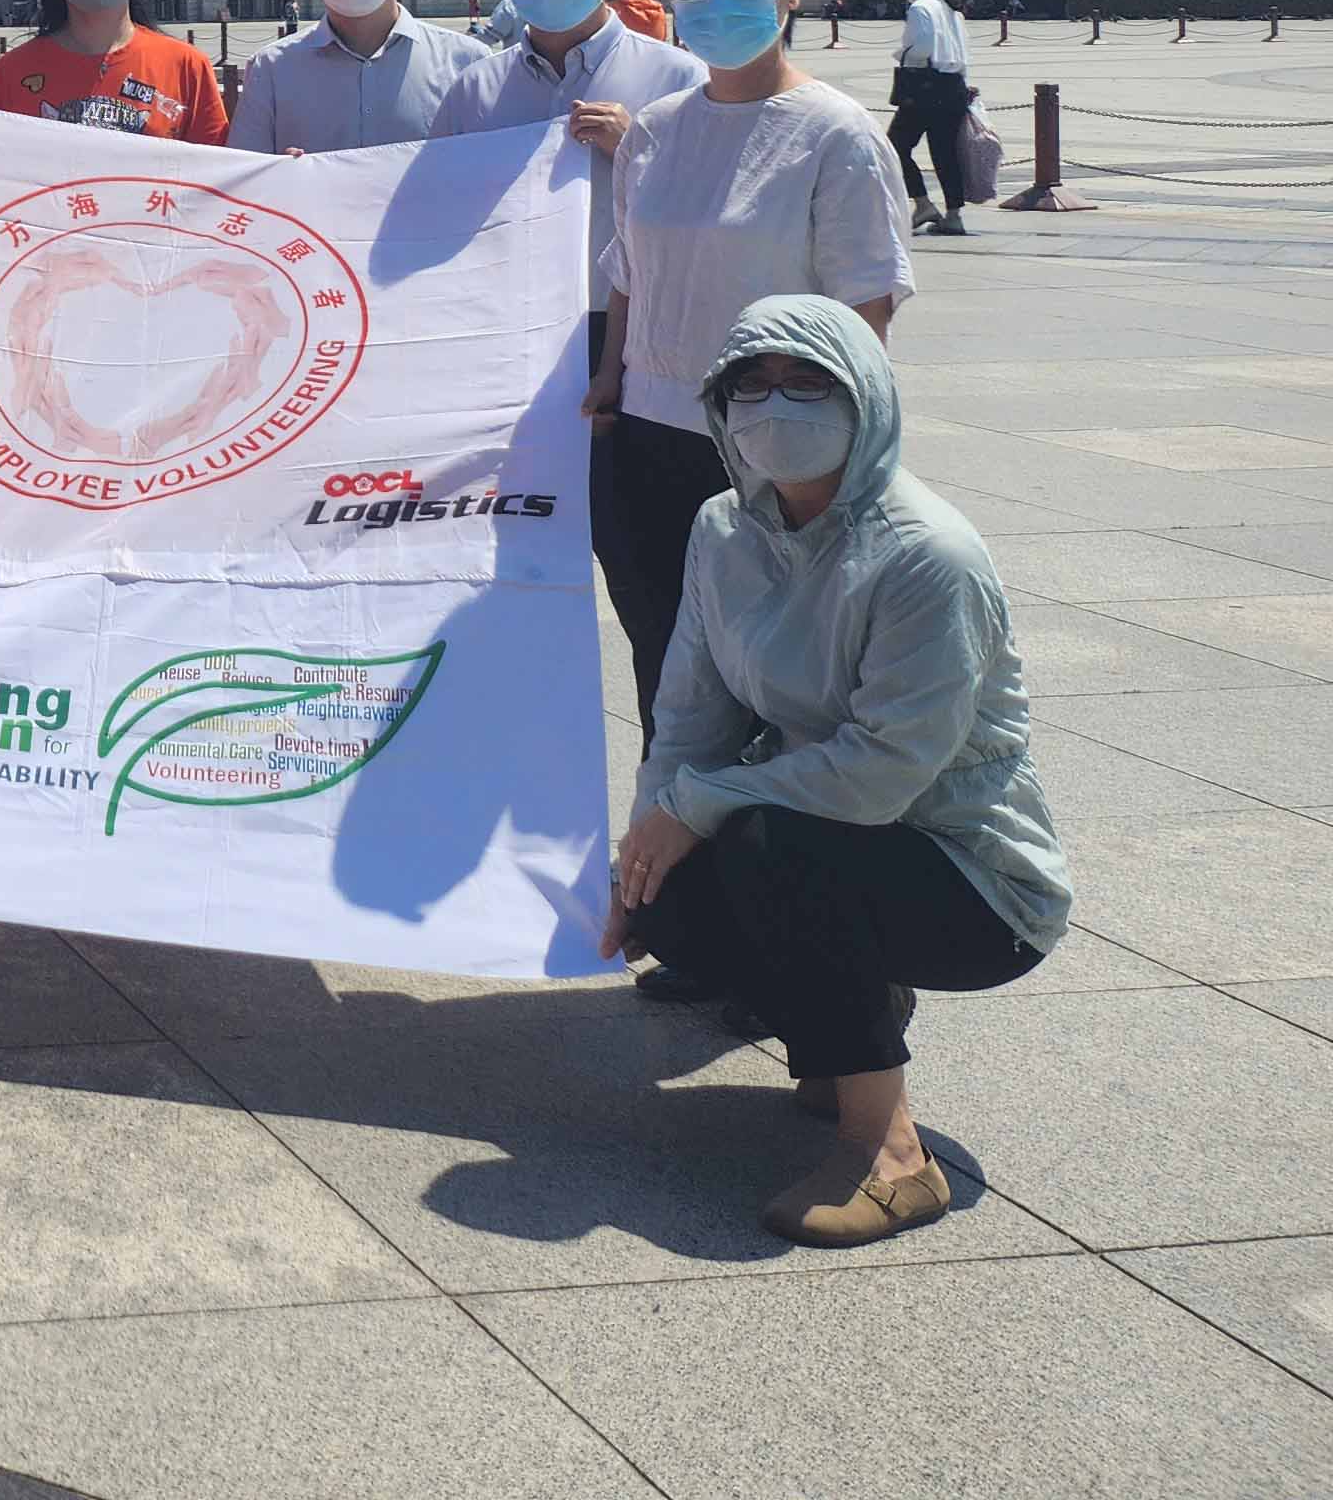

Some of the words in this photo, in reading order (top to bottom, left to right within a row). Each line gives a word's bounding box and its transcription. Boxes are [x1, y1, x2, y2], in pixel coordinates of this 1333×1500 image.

[123, 81, 153, 103] MUCH
[133, 338, 346, 495] VOLUNTEERING
[323, 469, 423, 498] OOCL
[303, 490, 557, 529] Logistics
[293, 666, 368, 683] Contribute
[43, 734, 73, 755] for
[146, 759, 282, 790] Volunteering
